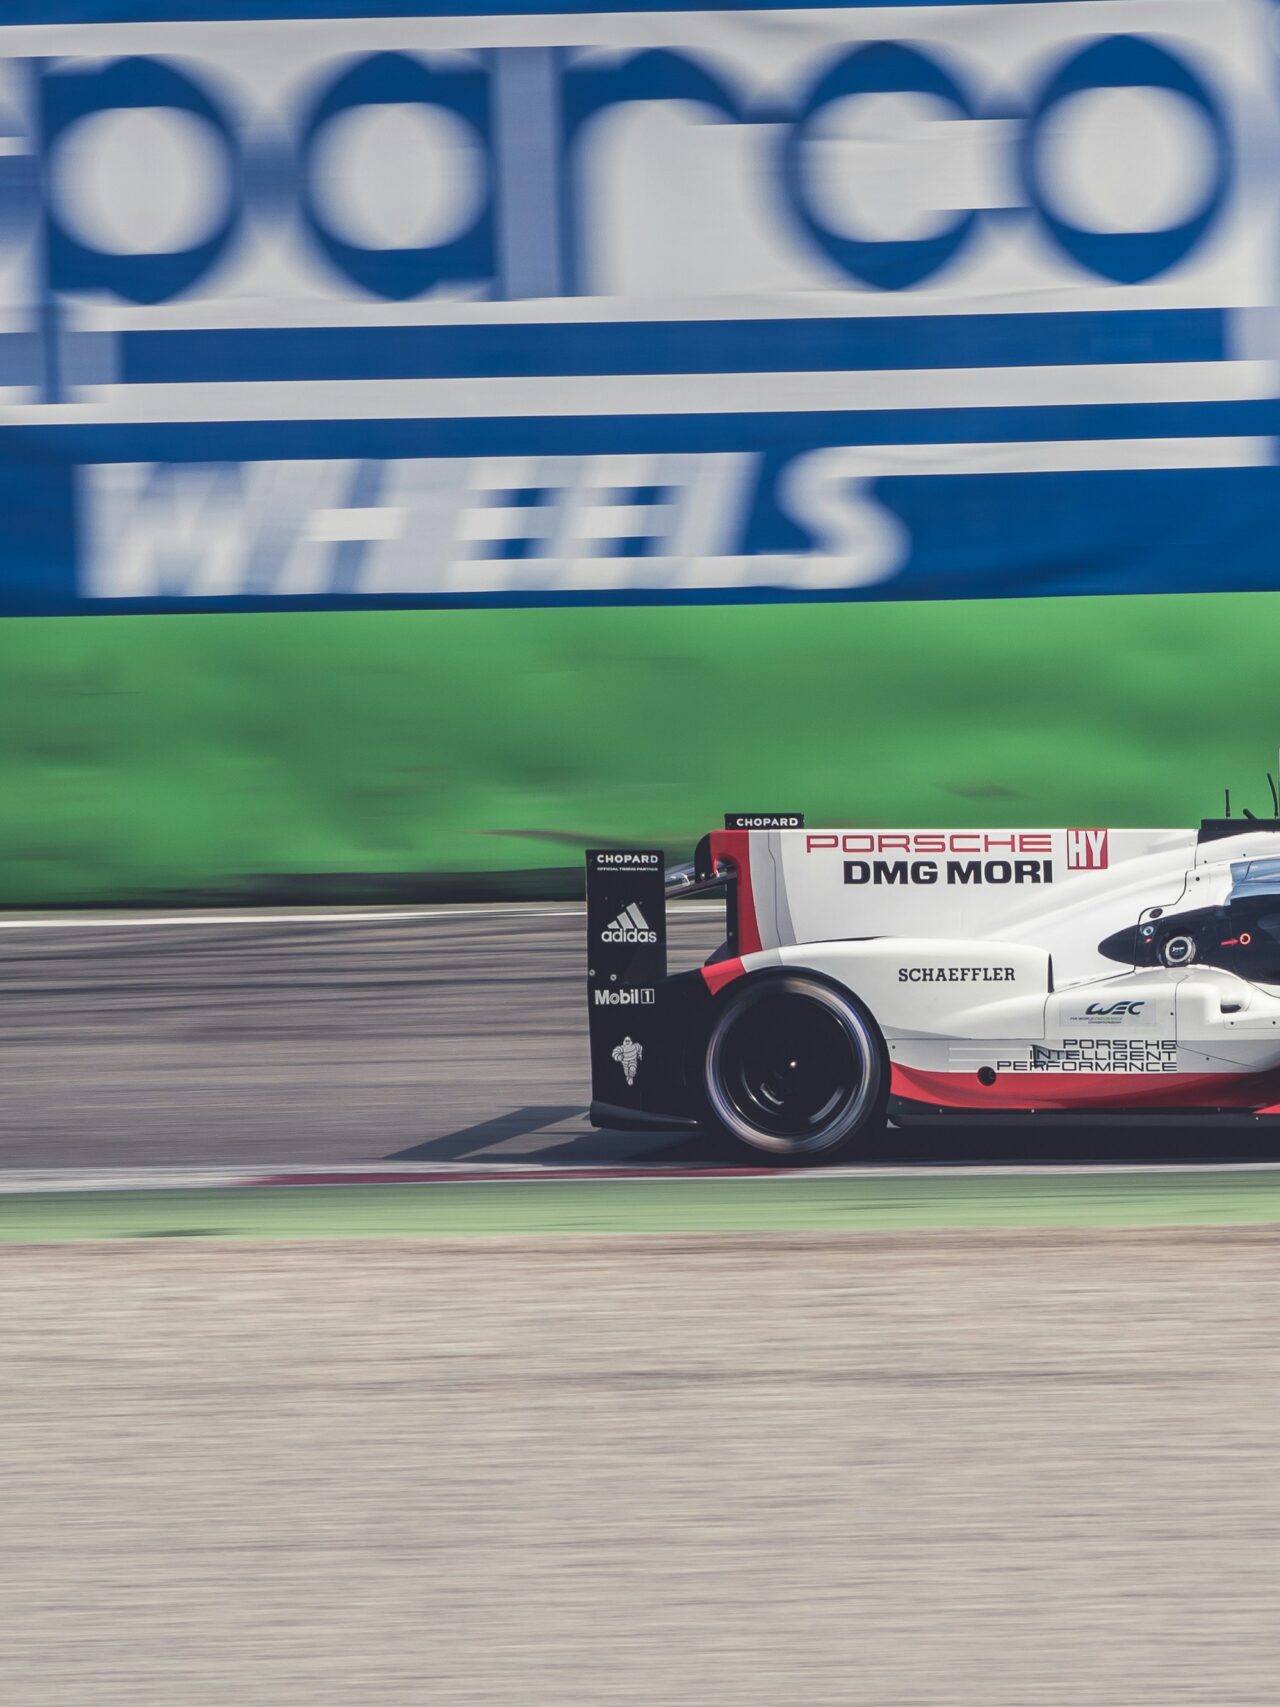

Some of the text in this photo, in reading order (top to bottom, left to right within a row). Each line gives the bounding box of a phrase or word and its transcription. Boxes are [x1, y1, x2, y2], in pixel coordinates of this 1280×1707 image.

[0, 33, 1238, 408] parco
[736, 817, 798, 827] CHOPARD
[806, 834, 1052, 853] PORSCHE
[1067, 830, 1108, 868] HY
[597, 854, 659, 864] CHOPARD
[843, 860, 1053, 885] DMG MORI
[601, 928, 657, 943] adidas
[898, 968, 1016, 982] SCHAEFFLER
[594, 989, 639, 1005] Mobil
[1085, 1001, 1145, 1015] WEC
[1063, 1039, 1177, 1049] PORSCHE
[1030, 1050, 1177, 1061] INTELLIGENT
[997, 1061, 1177, 1072] PERFORMANCE
